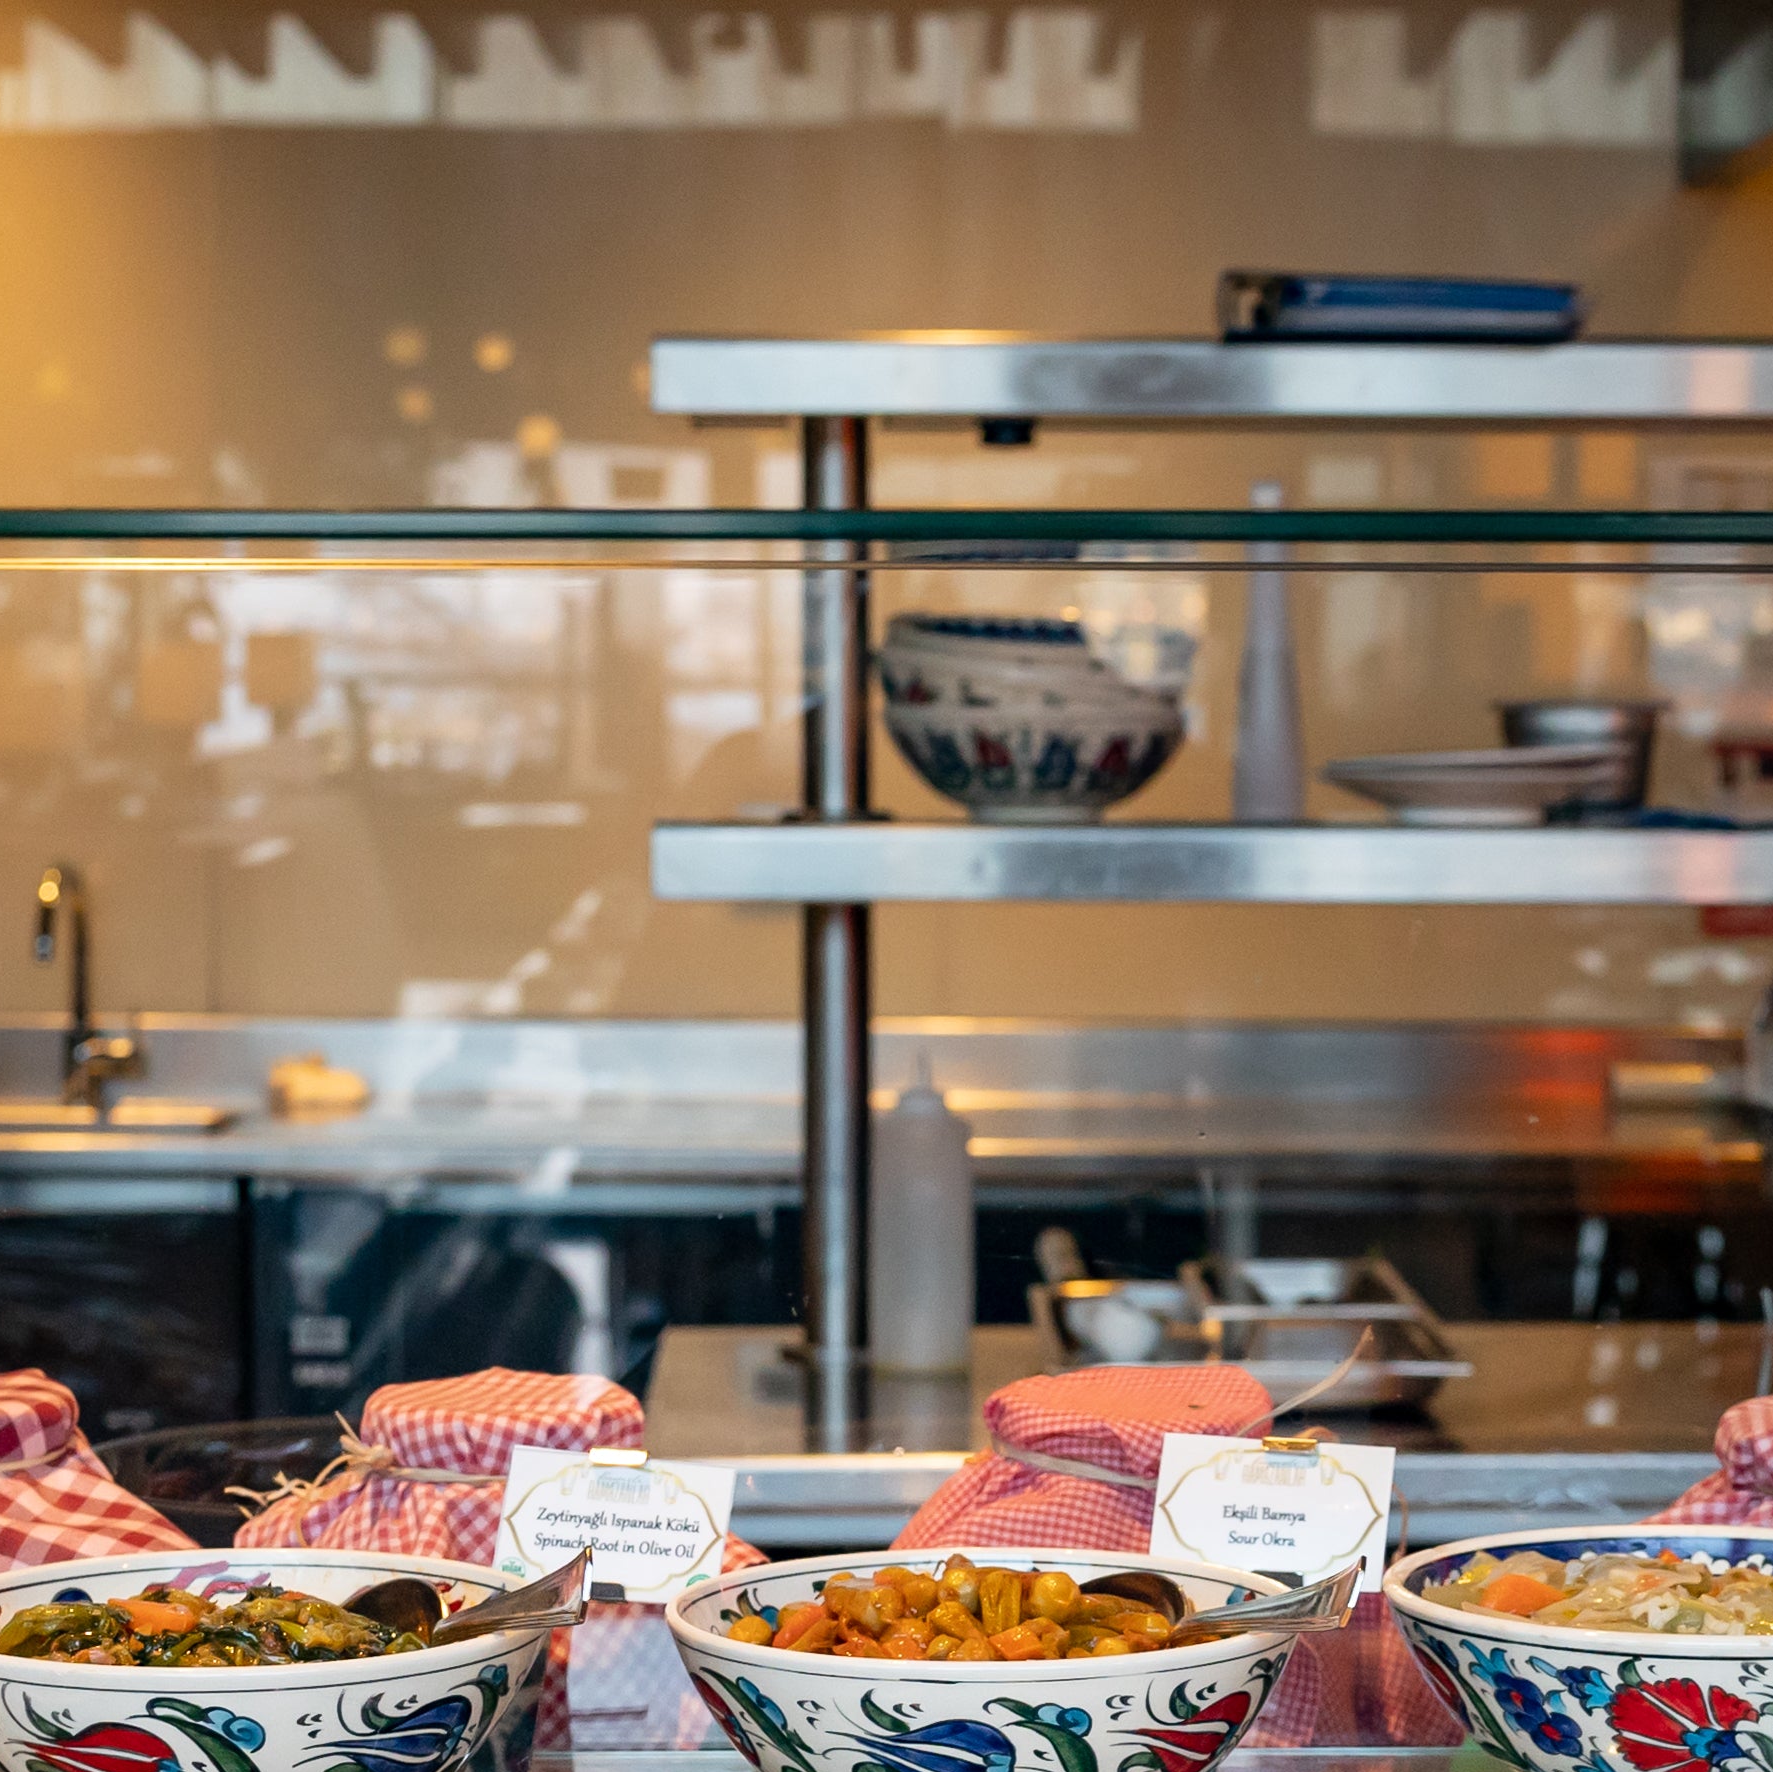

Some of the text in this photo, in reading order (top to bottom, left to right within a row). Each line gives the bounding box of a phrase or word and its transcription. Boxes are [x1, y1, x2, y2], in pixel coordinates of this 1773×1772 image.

[536, 1507, 607, 1530] Zeytinyağlı
[666, 1517, 700, 1533] Kökü
[1262, 1507, 1306, 1524] Bamya
[534, 1533, 695, 1560] Spinach Root in Olive Oil
[1228, 1531, 1296, 1547] Sour Okra
